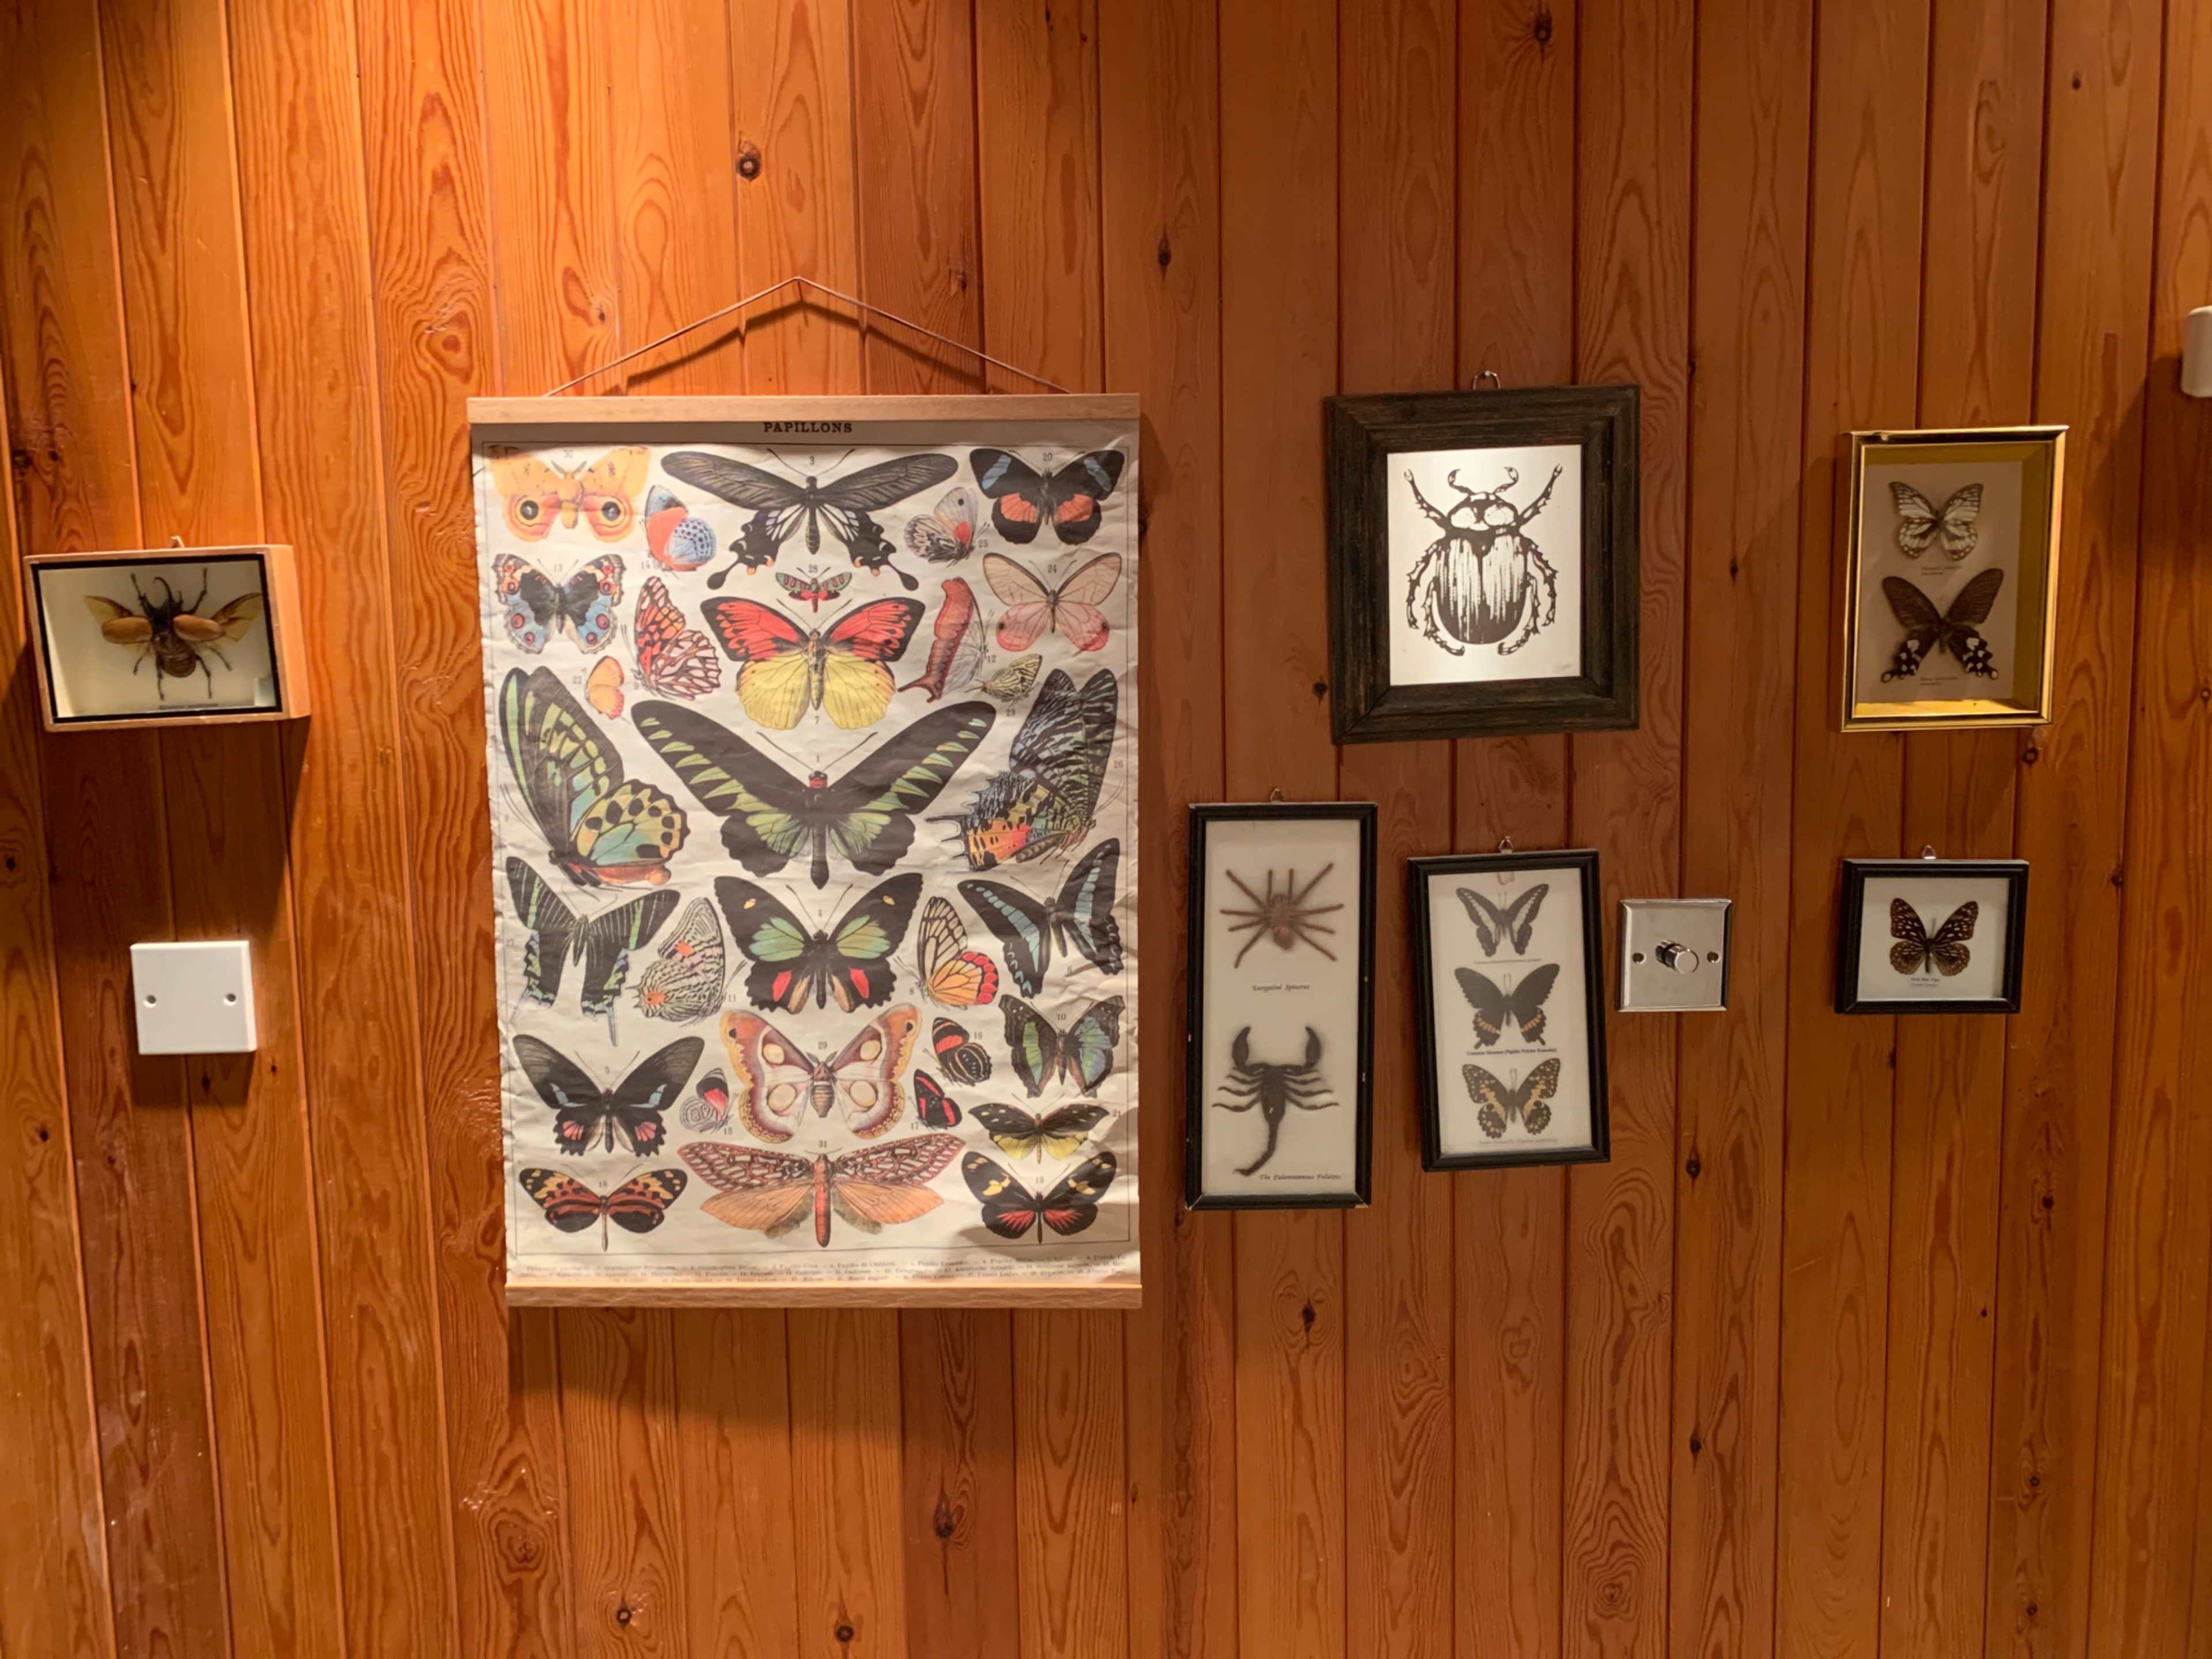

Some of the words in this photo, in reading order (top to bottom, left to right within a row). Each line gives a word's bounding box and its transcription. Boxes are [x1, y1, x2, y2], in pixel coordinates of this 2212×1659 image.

[764, 422, 853, 433] PAPILLONS
[810, 456, 815, 465] 3
[1043, 453, 1052, 461] 20
[1048, 565, 1057, 573] 24
[814, 716, 820, 724] 7
[819, 1140, 827, 1148] 31
